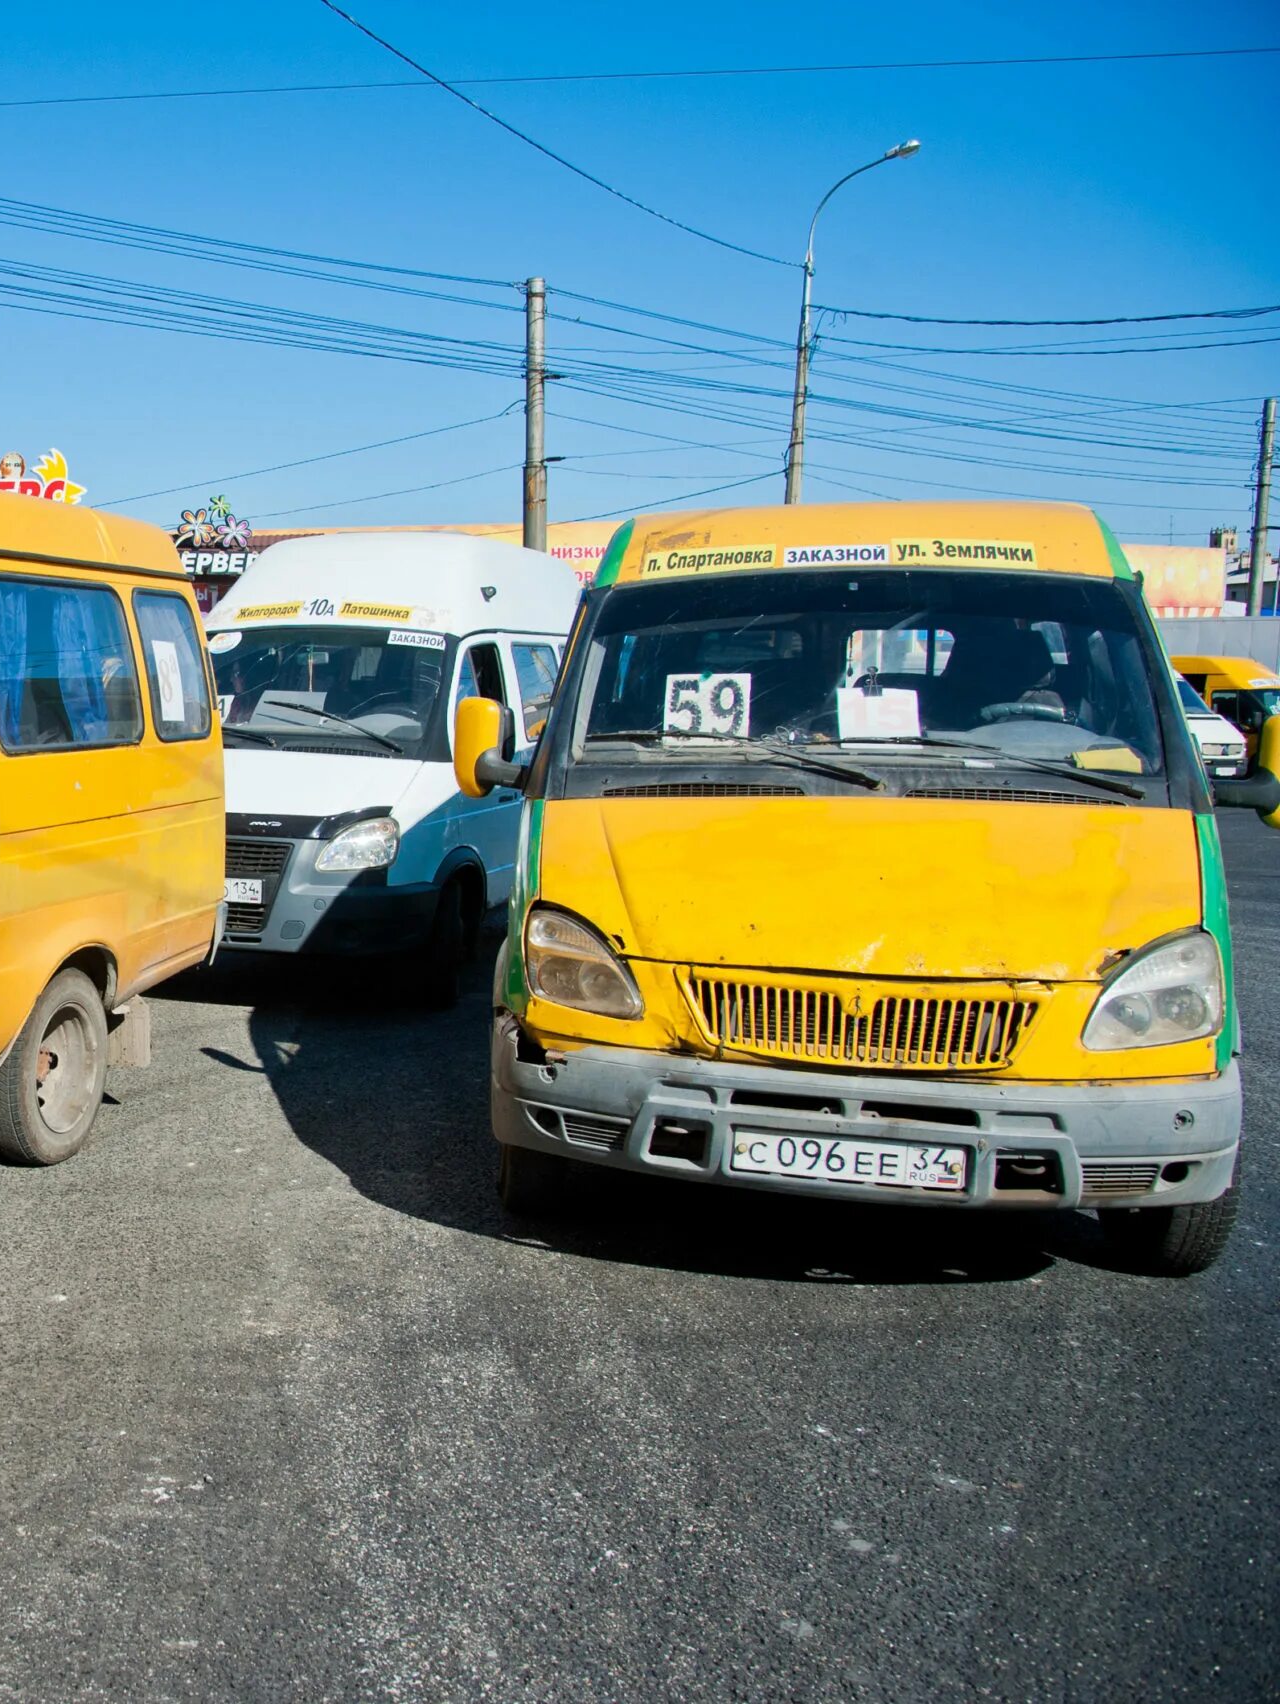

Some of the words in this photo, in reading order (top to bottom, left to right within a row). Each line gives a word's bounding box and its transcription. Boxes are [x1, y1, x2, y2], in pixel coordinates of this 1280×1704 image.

[787, 545, 886, 563] ЗАКАЗНОЙ
[896, 542, 926, 561] ул.
[932, 540, 1034, 562] Землячки
[667, 549, 773, 572] Спартановка
[237, 604, 300, 619] Жилгородок
[341, 603, 410, 619] Латошинка
[668, 678, 745, 741] 59
[233, 881, 256, 895] 134
[913, 1148, 950, 1172] 34
[909, 1171, 937, 1182] RUS
